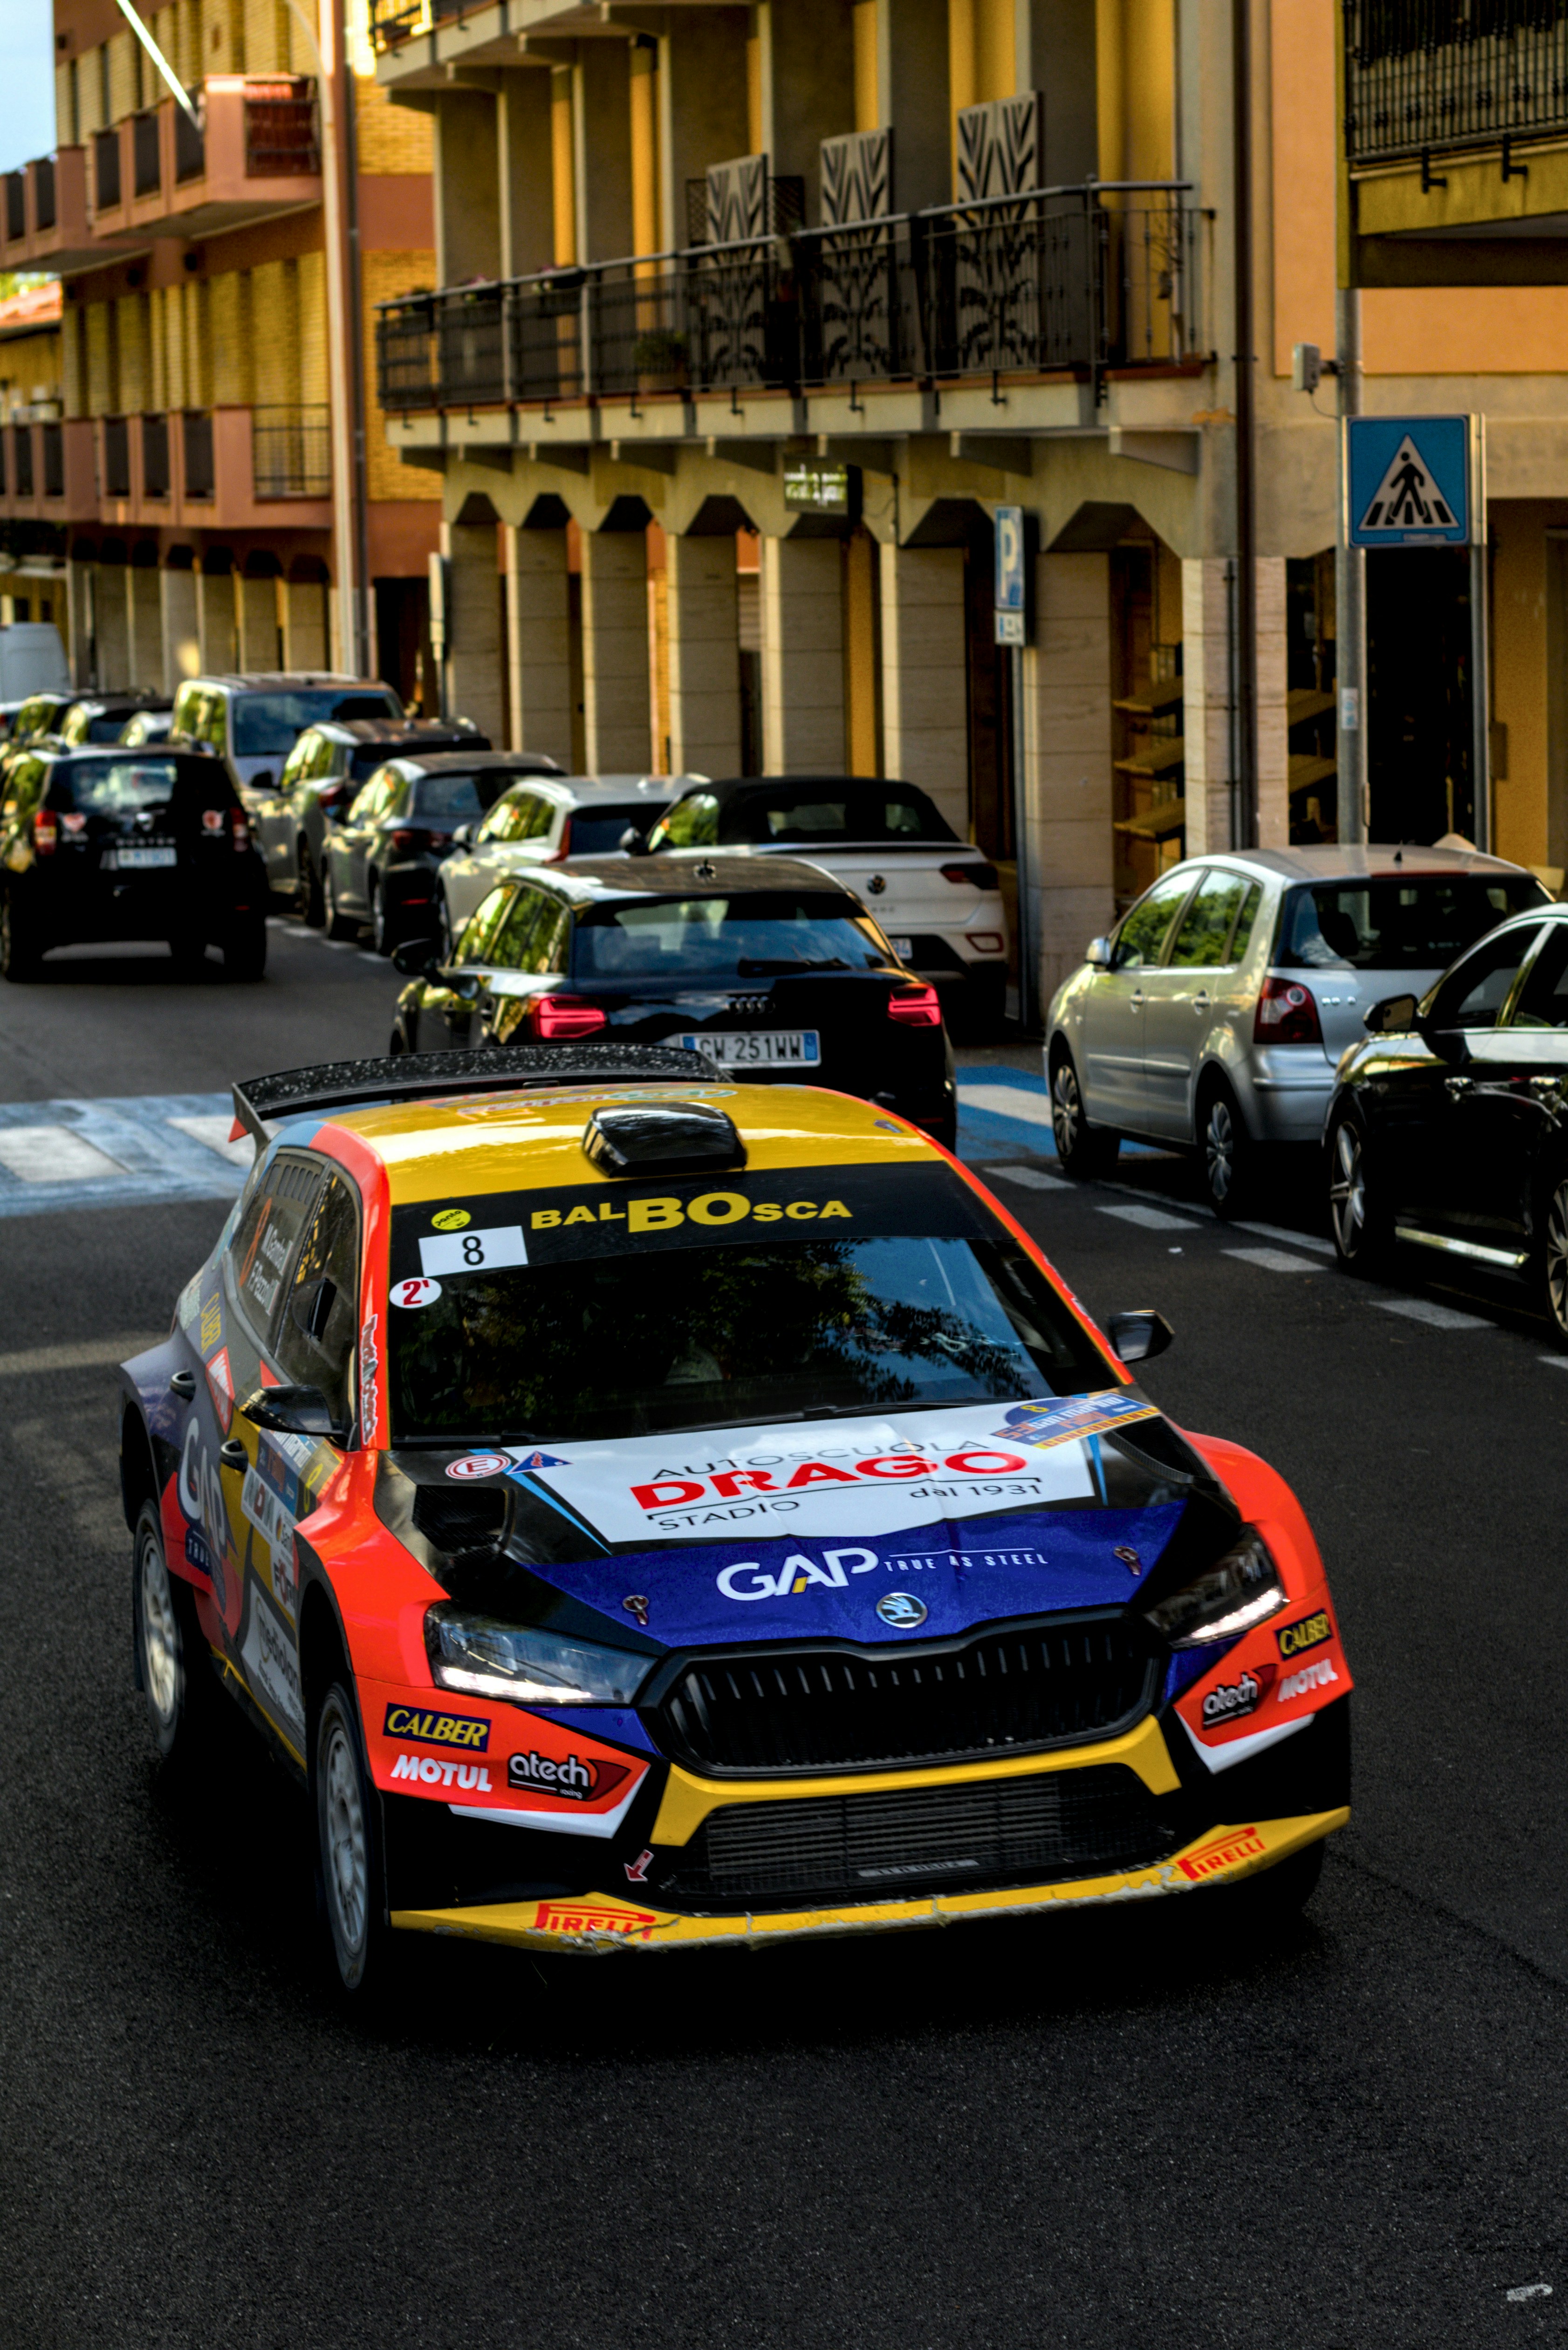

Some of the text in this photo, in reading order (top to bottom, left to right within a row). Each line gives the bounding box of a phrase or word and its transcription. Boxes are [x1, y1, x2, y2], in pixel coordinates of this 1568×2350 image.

[531, 1192, 853, 1233] BALBOSCA
[462, 1236, 485, 1266] 8
[466, 1459, 490, 1473] E
[652, 1440, 991, 1480] AUTOSCUOLA
[630, 1451, 1028, 1510] DRAGO
[910, 1483, 1042, 1497] dal 1931
[659, 1500, 801, 1531] STADIO
[716, 1547, 879, 1601] GAP
[883, 1558, 937, 1572] TRUE
[984, 1554, 1049, 1566] STEEL
[387, 1709, 488, 1747] CALBER
[390, 1754, 493, 1793] MOTUL
[509, 1751, 589, 1788] atech
[1177, 1826, 1267, 1881] PIRELLI
